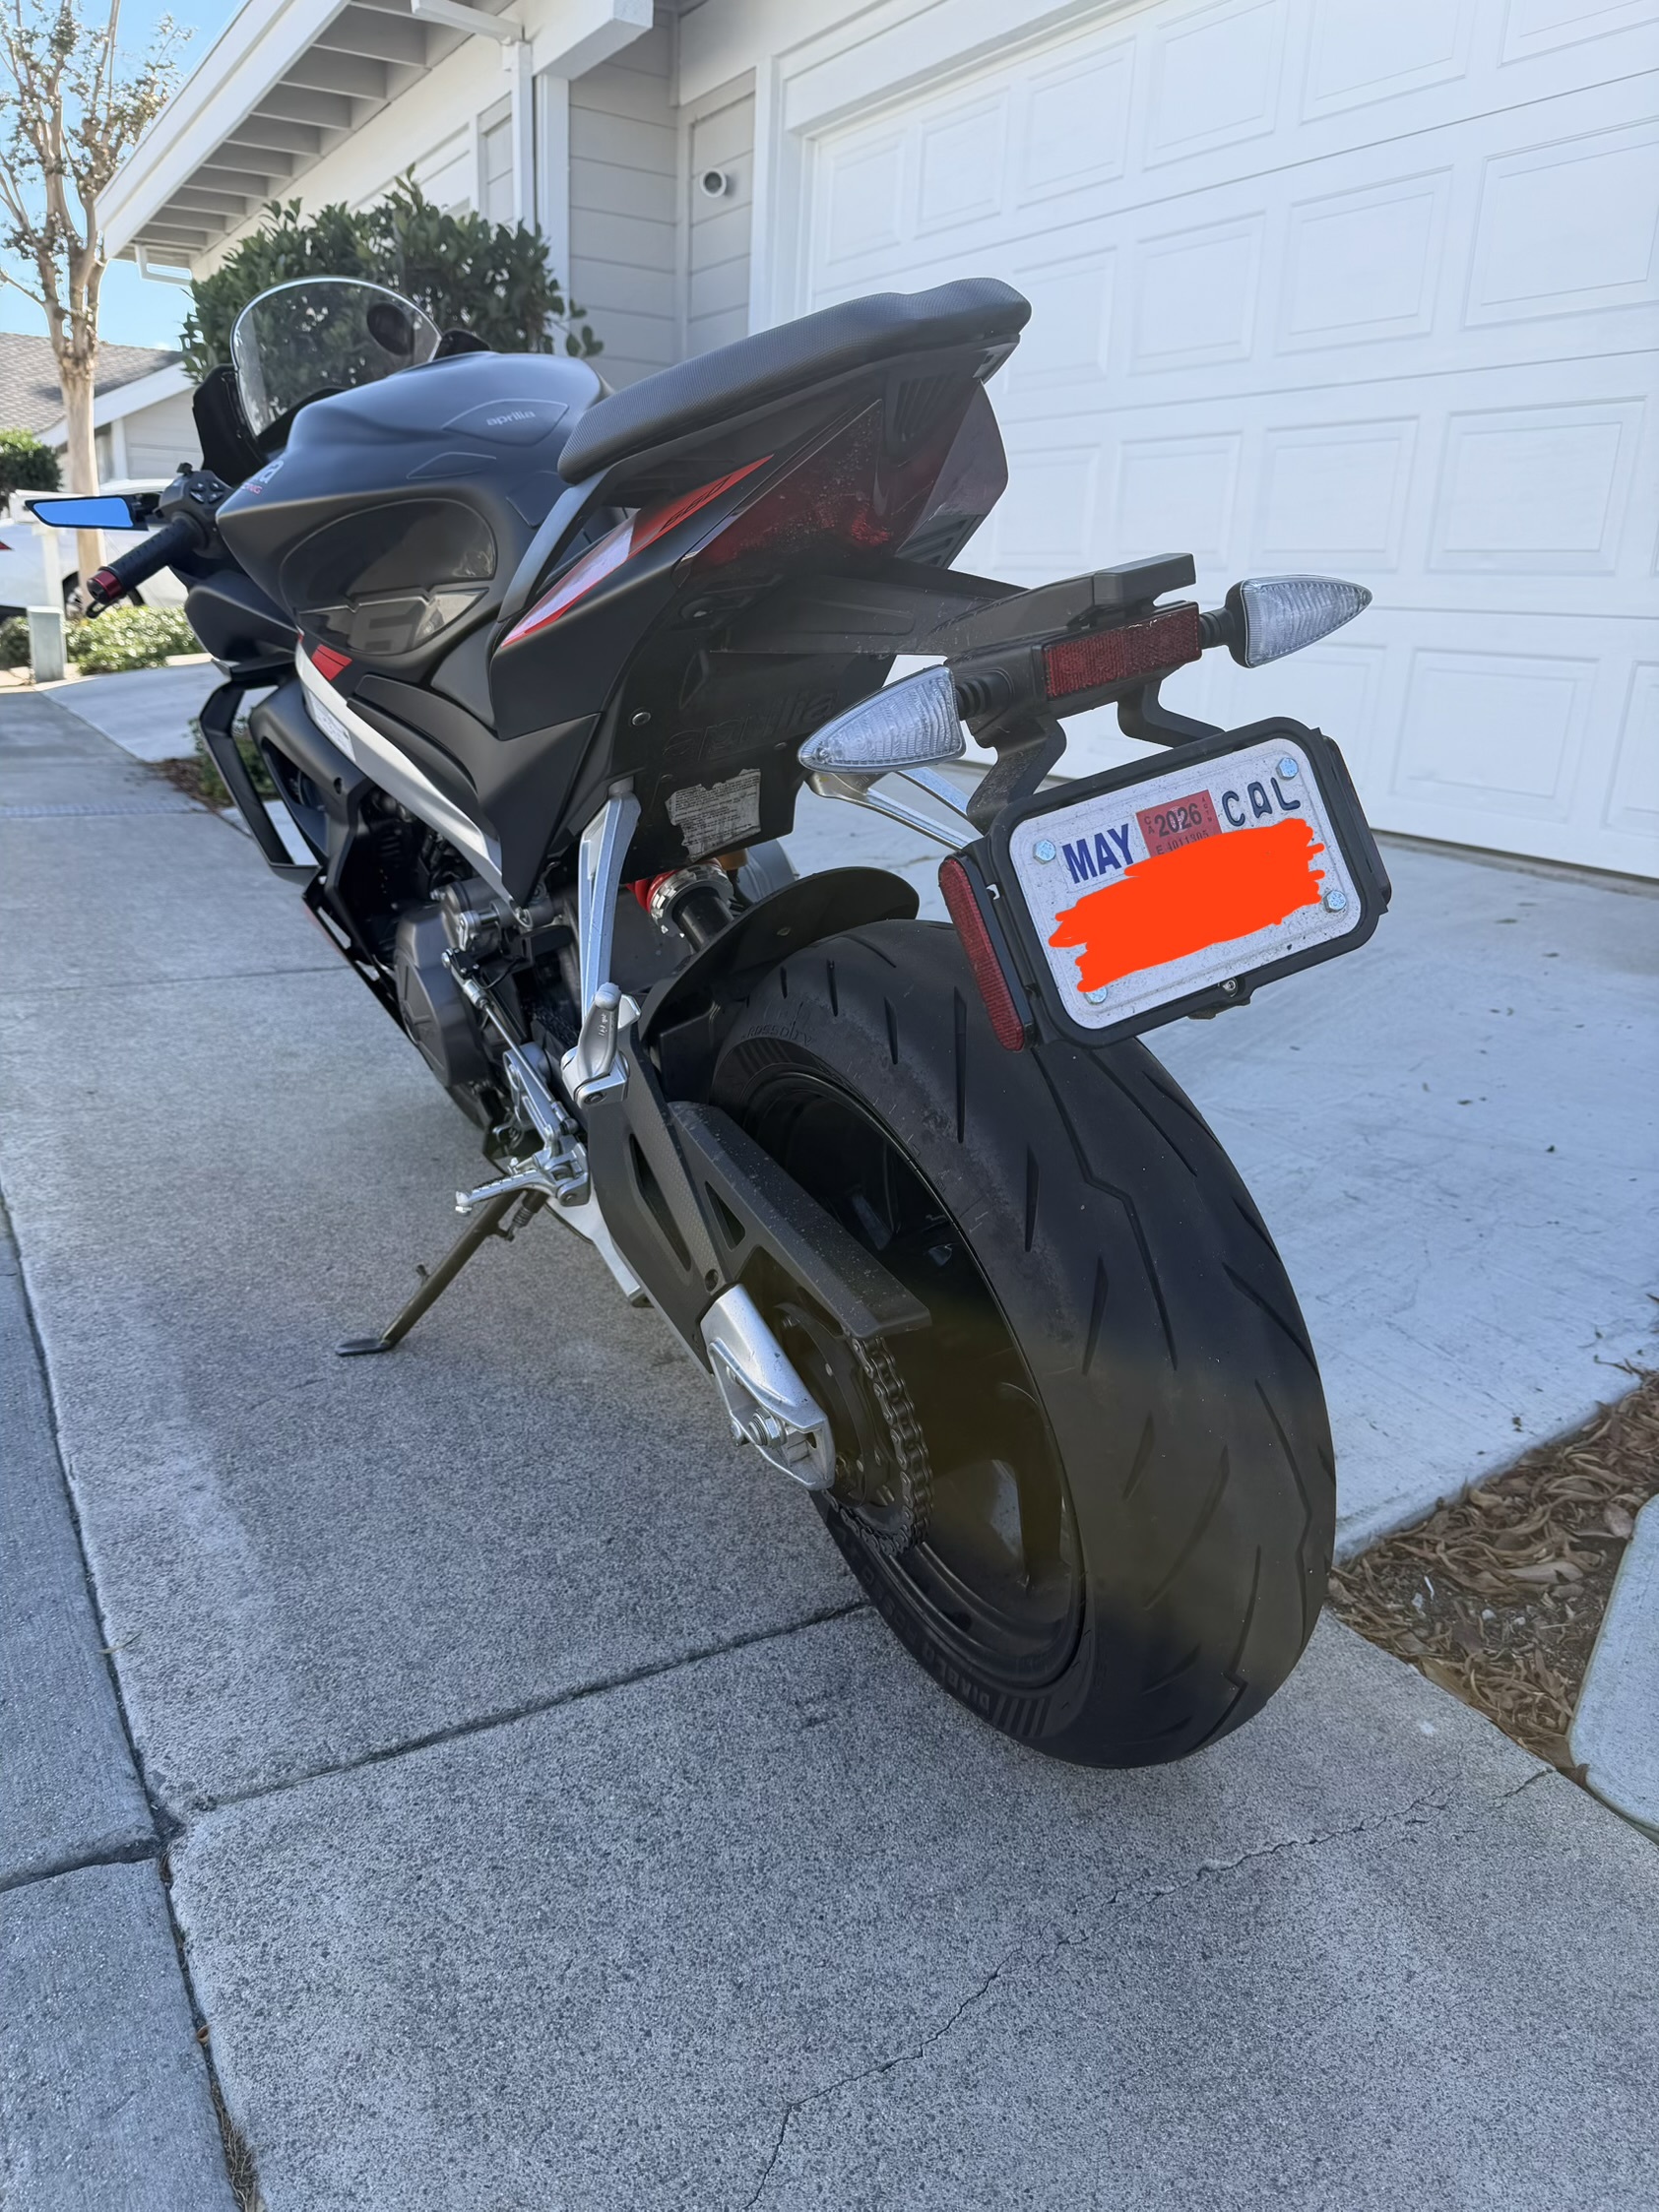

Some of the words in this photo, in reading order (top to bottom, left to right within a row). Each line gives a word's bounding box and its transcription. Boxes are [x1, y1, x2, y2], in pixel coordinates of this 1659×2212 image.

[486, 410, 537, 426] aprilia
[1154, 802, 1202, 837] 2026
[1221, 777, 1301, 827] CAL
[1061, 823, 1133, 884] MAY
